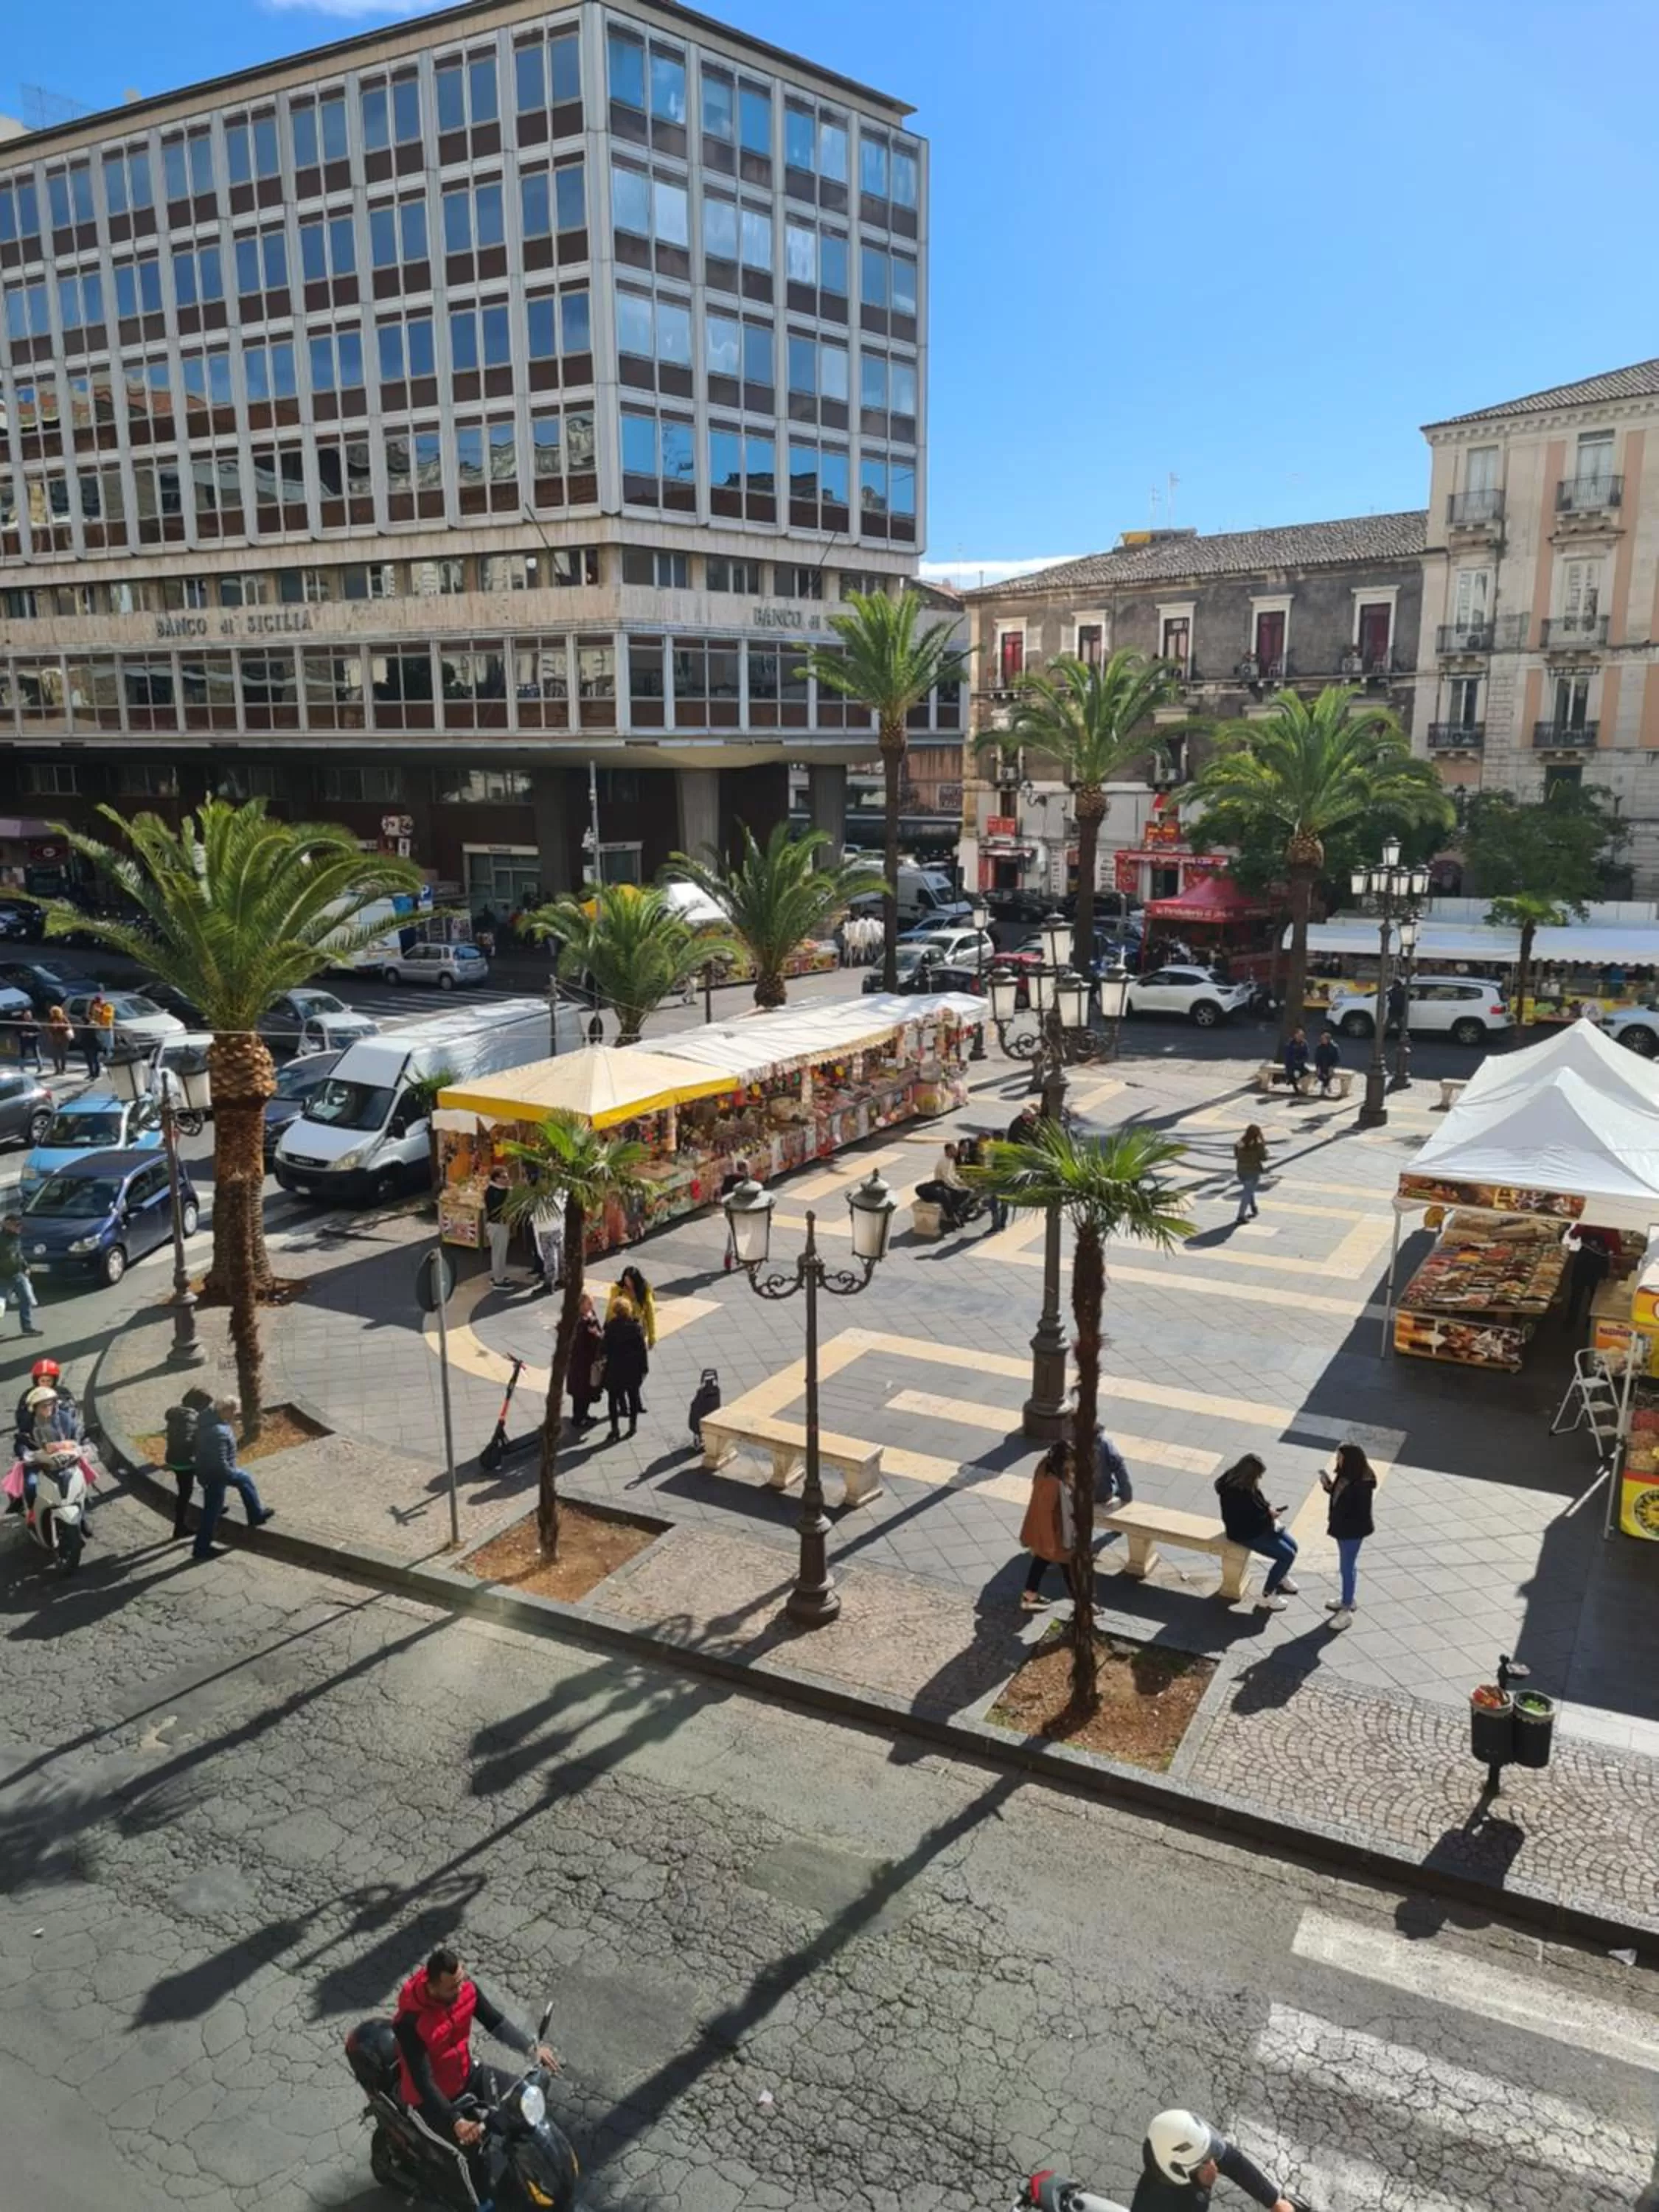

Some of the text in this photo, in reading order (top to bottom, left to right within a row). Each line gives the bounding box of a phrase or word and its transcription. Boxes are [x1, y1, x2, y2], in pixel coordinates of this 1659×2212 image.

[156, 616, 207, 639] BANCO
[247, 608, 313, 633] SICILIA
[753, 607, 801, 627] BANCO
